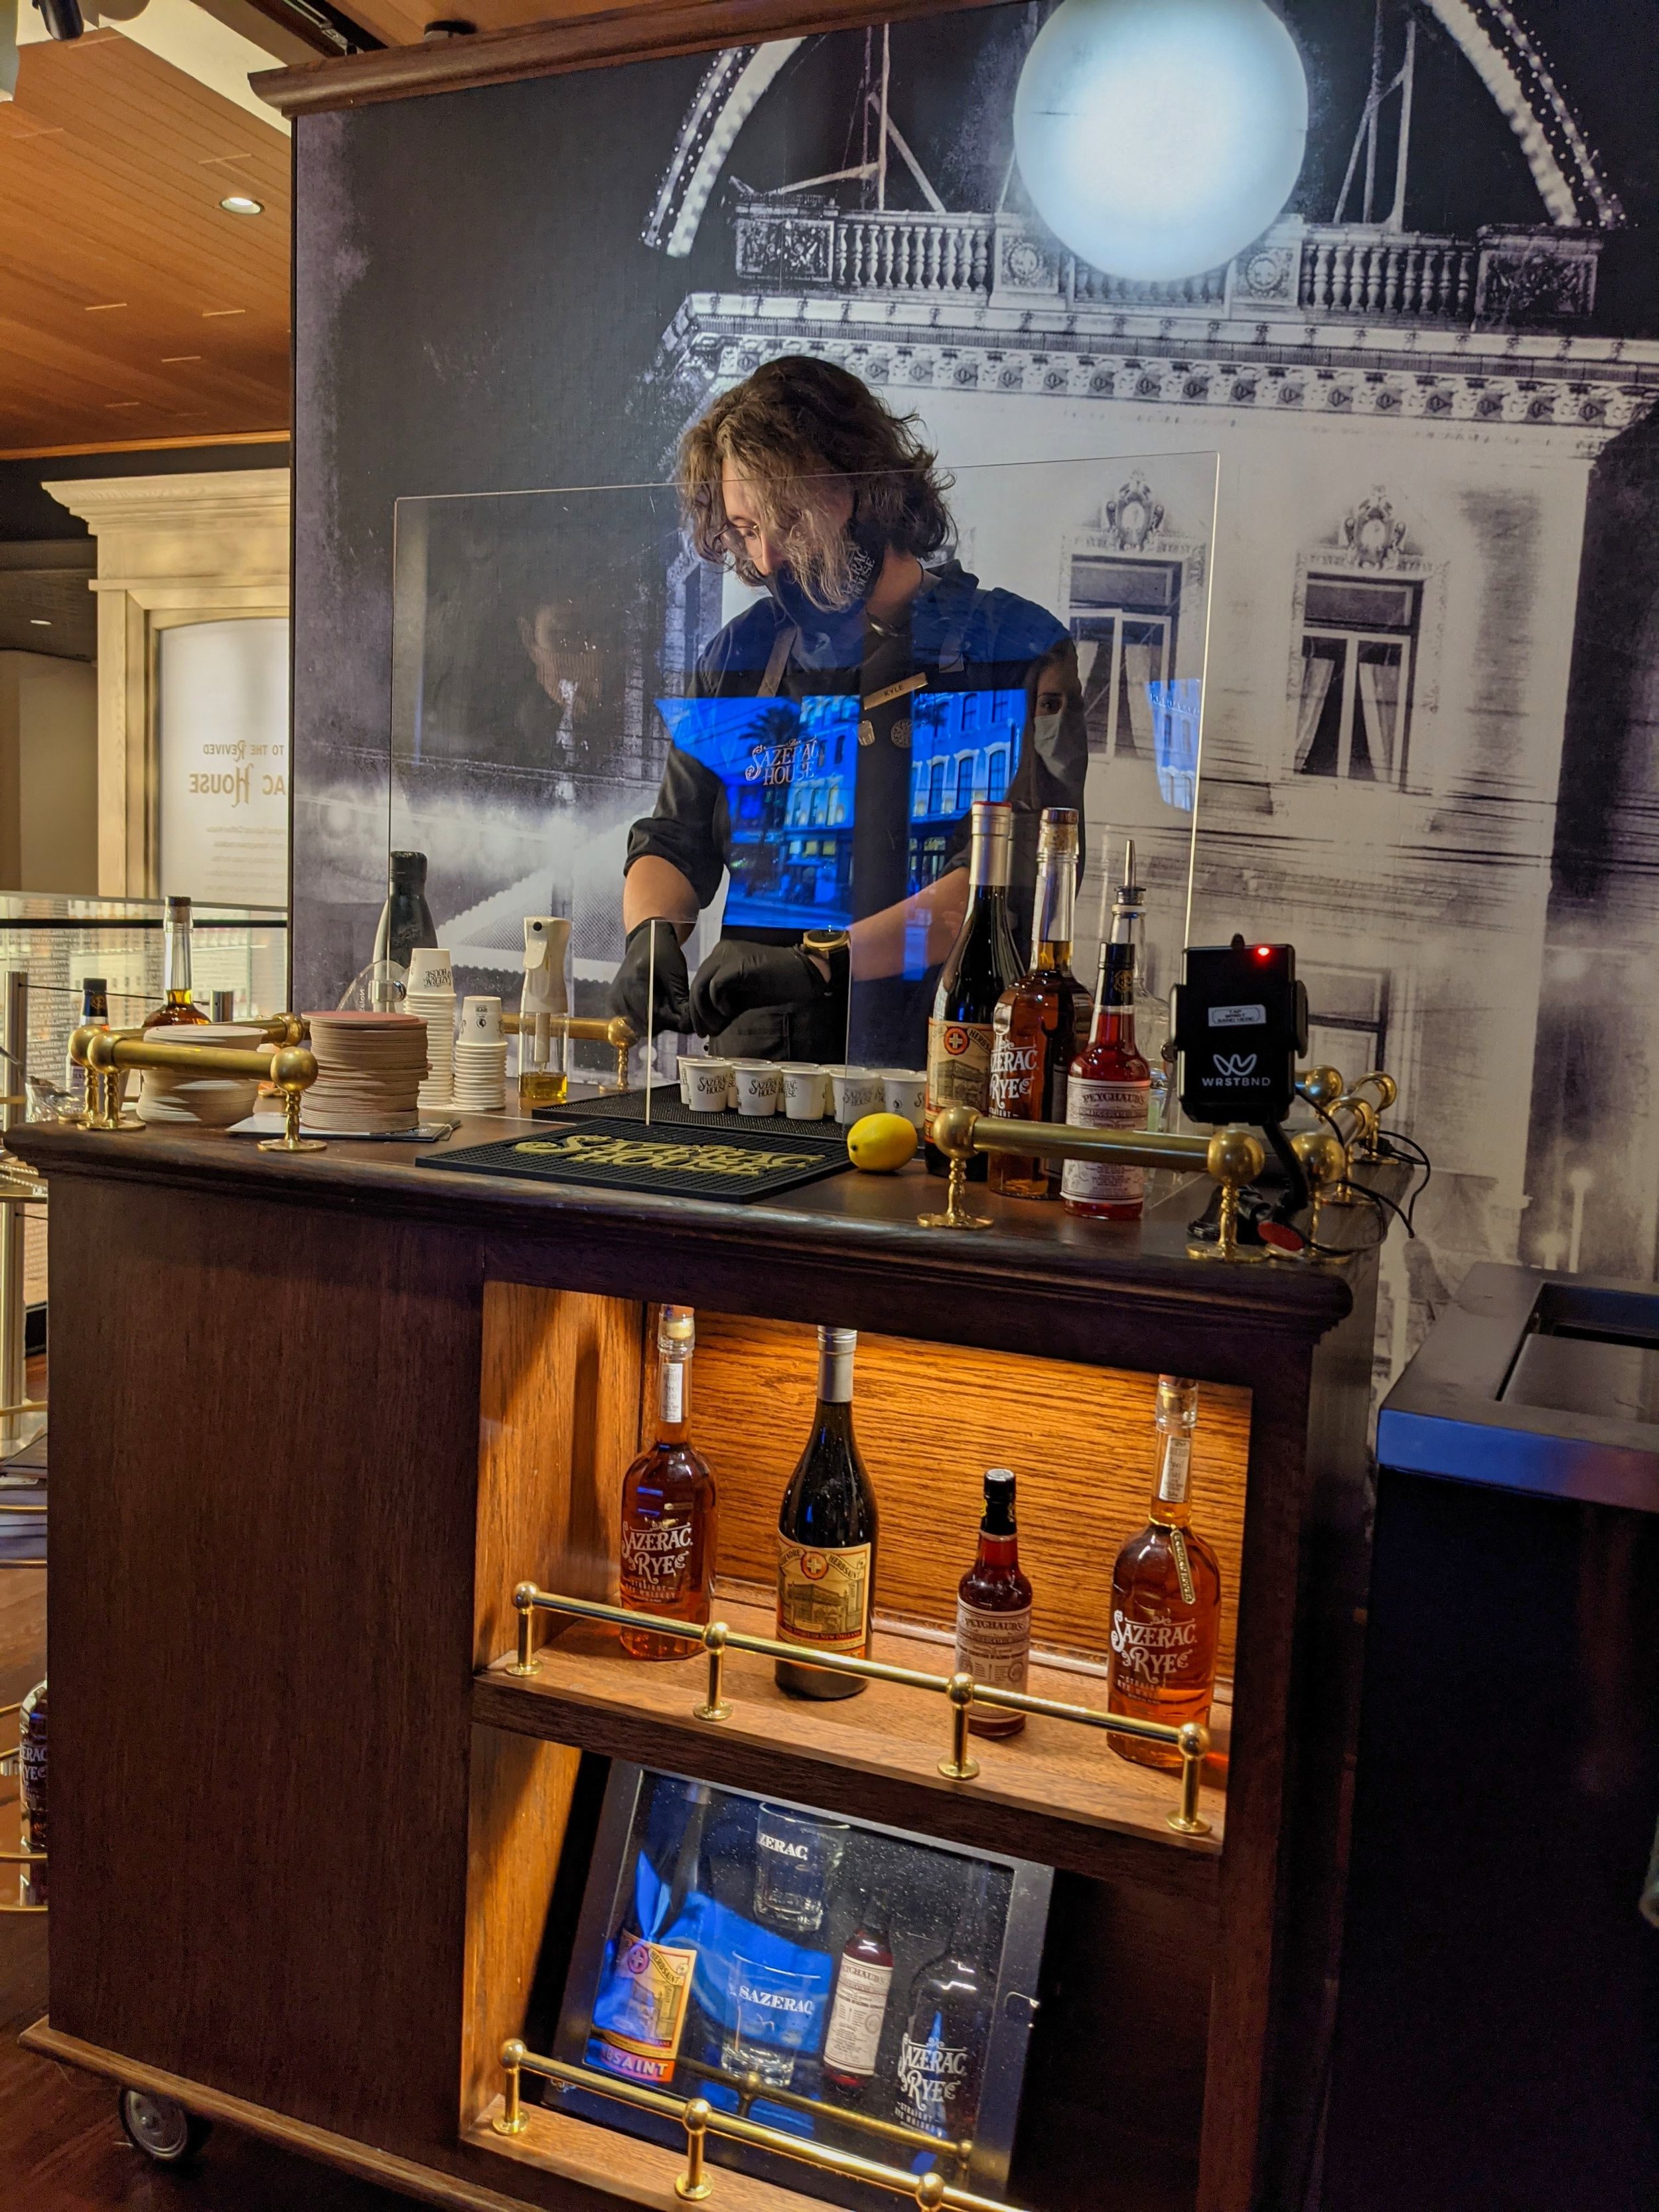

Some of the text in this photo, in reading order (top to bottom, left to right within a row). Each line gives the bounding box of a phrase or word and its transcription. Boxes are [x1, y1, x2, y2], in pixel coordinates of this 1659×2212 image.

[884, 685, 903, 697] KYLE
[745, 739, 819, 781] SAZERAC
[763, 762, 815, 786] HOUSE
[991, 1074, 1020, 1108] RYE
[1202, 1077, 1271, 1086] WRSTBND
[515, 1135, 813, 1169] SAZERAC
[567, 1149, 759, 1176] HOUSE
[622, 1521, 692, 1558] SAZERAC
[634, 1552, 676, 1585] RYE
[1111, 1609, 1196, 1652] SAZERAC
[1129, 1647, 1177, 1684] RYE
[650, 1952, 681, 1984] HERBSAINT
[739, 1985, 814, 2016] SAZERAC
[898, 2032, 968, 2078] SAZERAC
[906, 2069, 946, 2112] RYE
